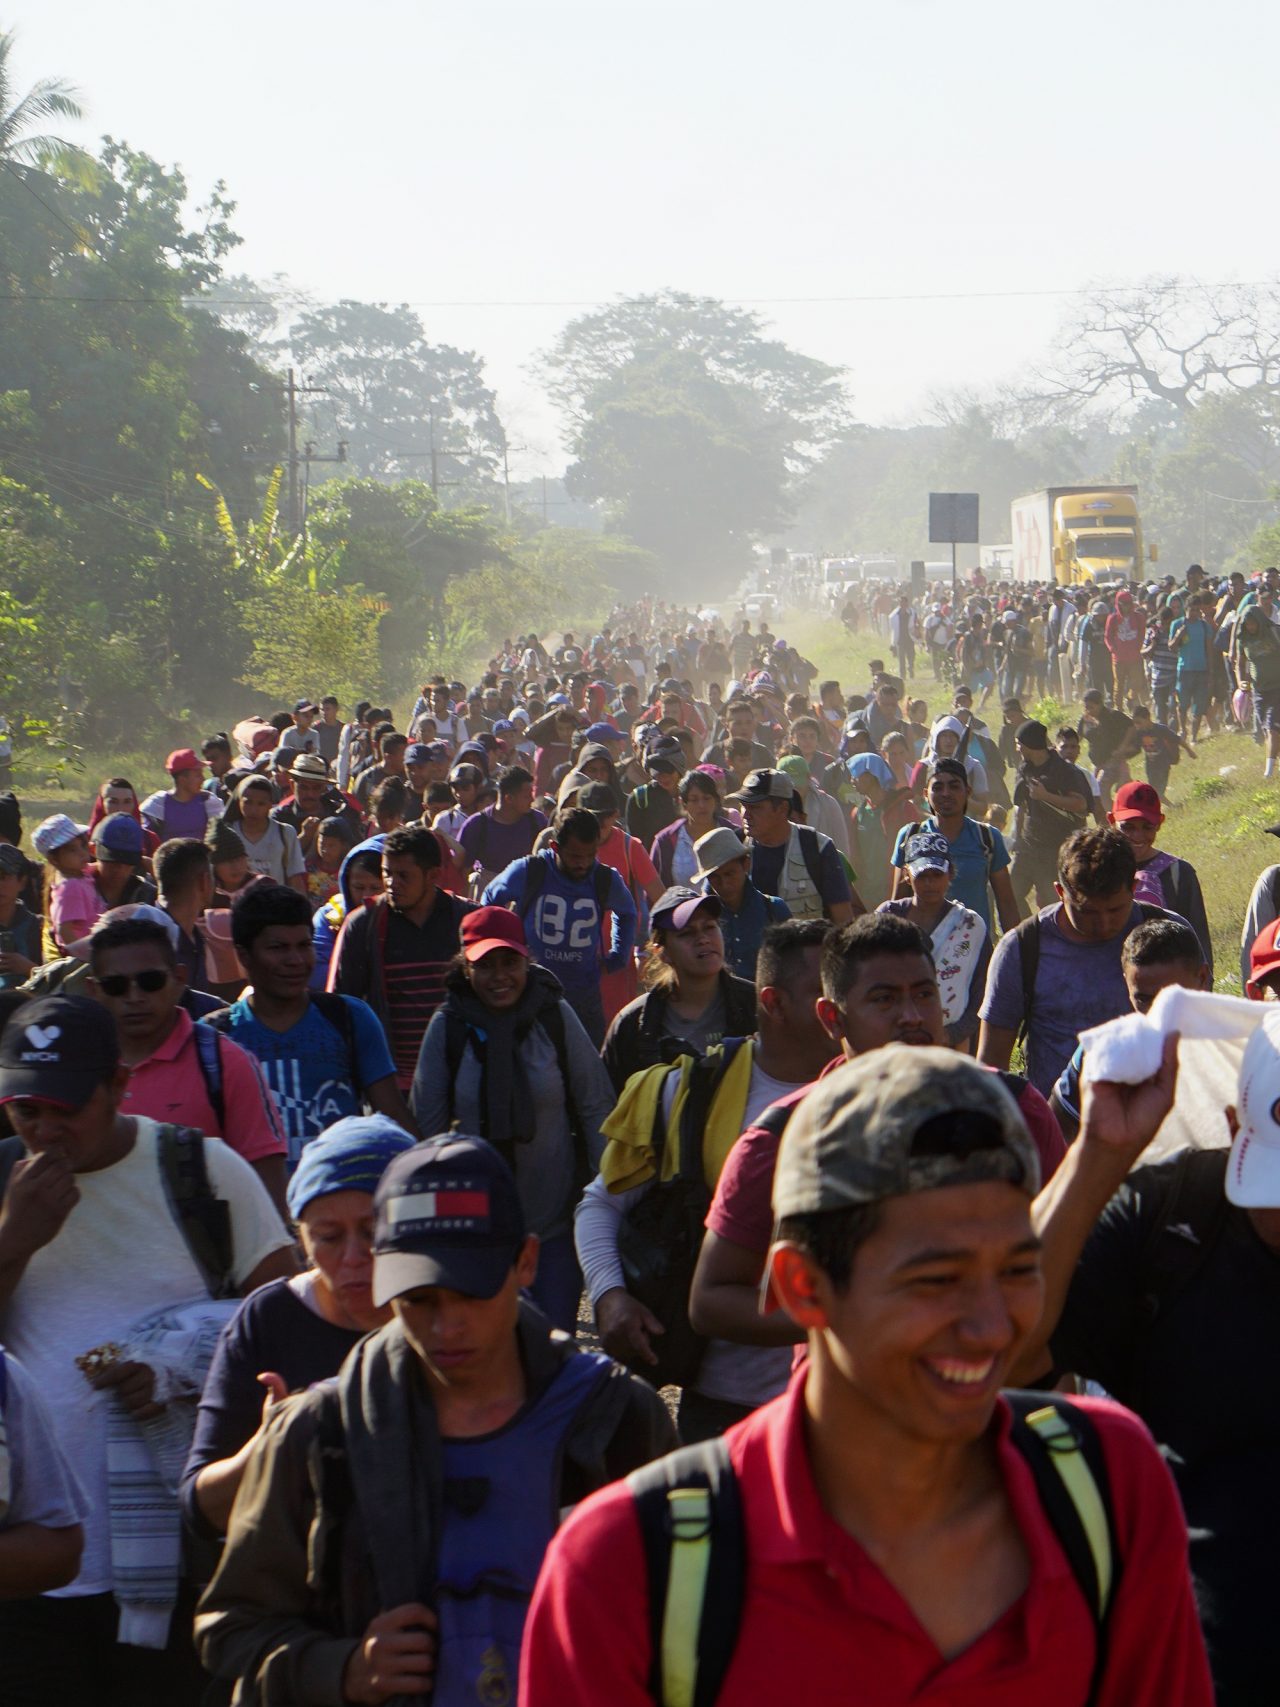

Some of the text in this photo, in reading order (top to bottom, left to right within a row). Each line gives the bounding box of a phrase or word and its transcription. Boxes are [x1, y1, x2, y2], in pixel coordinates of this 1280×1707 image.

[544, 948, 583, 962] CHAMPS
[399, 1180, 473, 1192] TOMMY
[398, 1219, 474, 1233] HILFIGER
